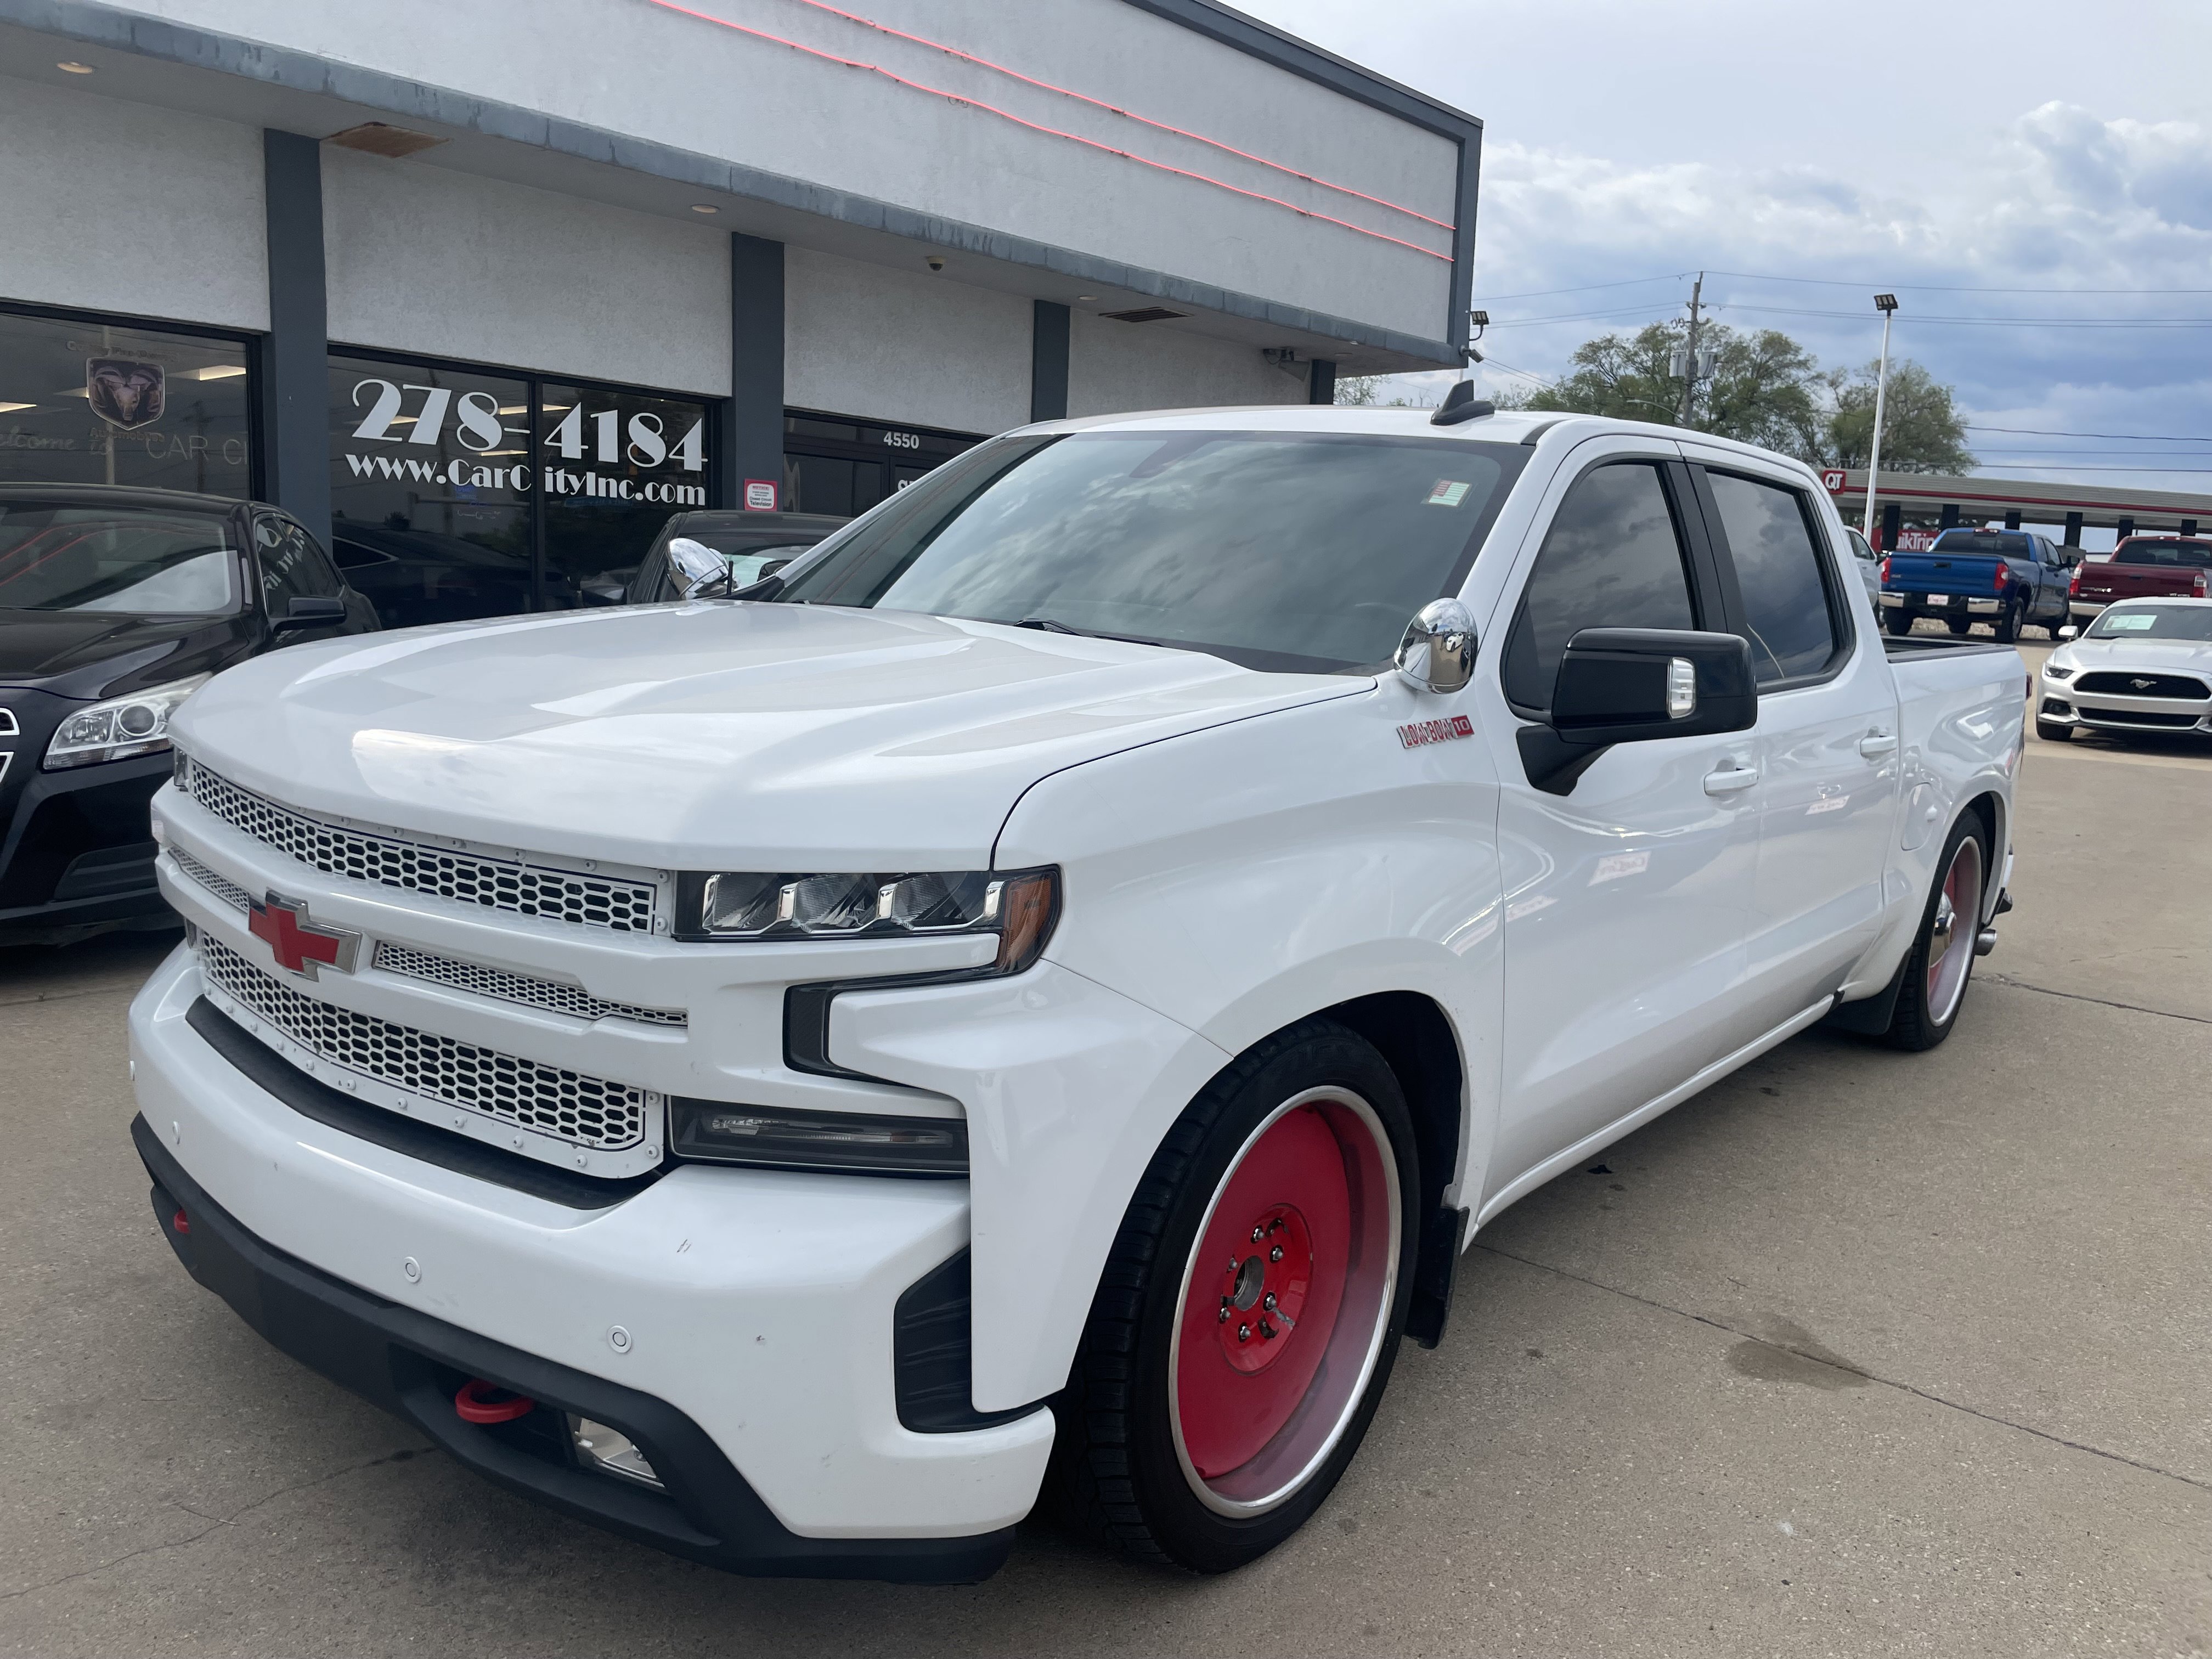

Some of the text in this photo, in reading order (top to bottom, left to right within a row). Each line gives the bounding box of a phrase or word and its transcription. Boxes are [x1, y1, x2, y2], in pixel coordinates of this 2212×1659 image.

[146, 433, 209, 460] CAR
[883, 431, 919, 449] 4550
[1825, 472, 1843, 490] QT
[1454, 719, 1470, 732] 10
